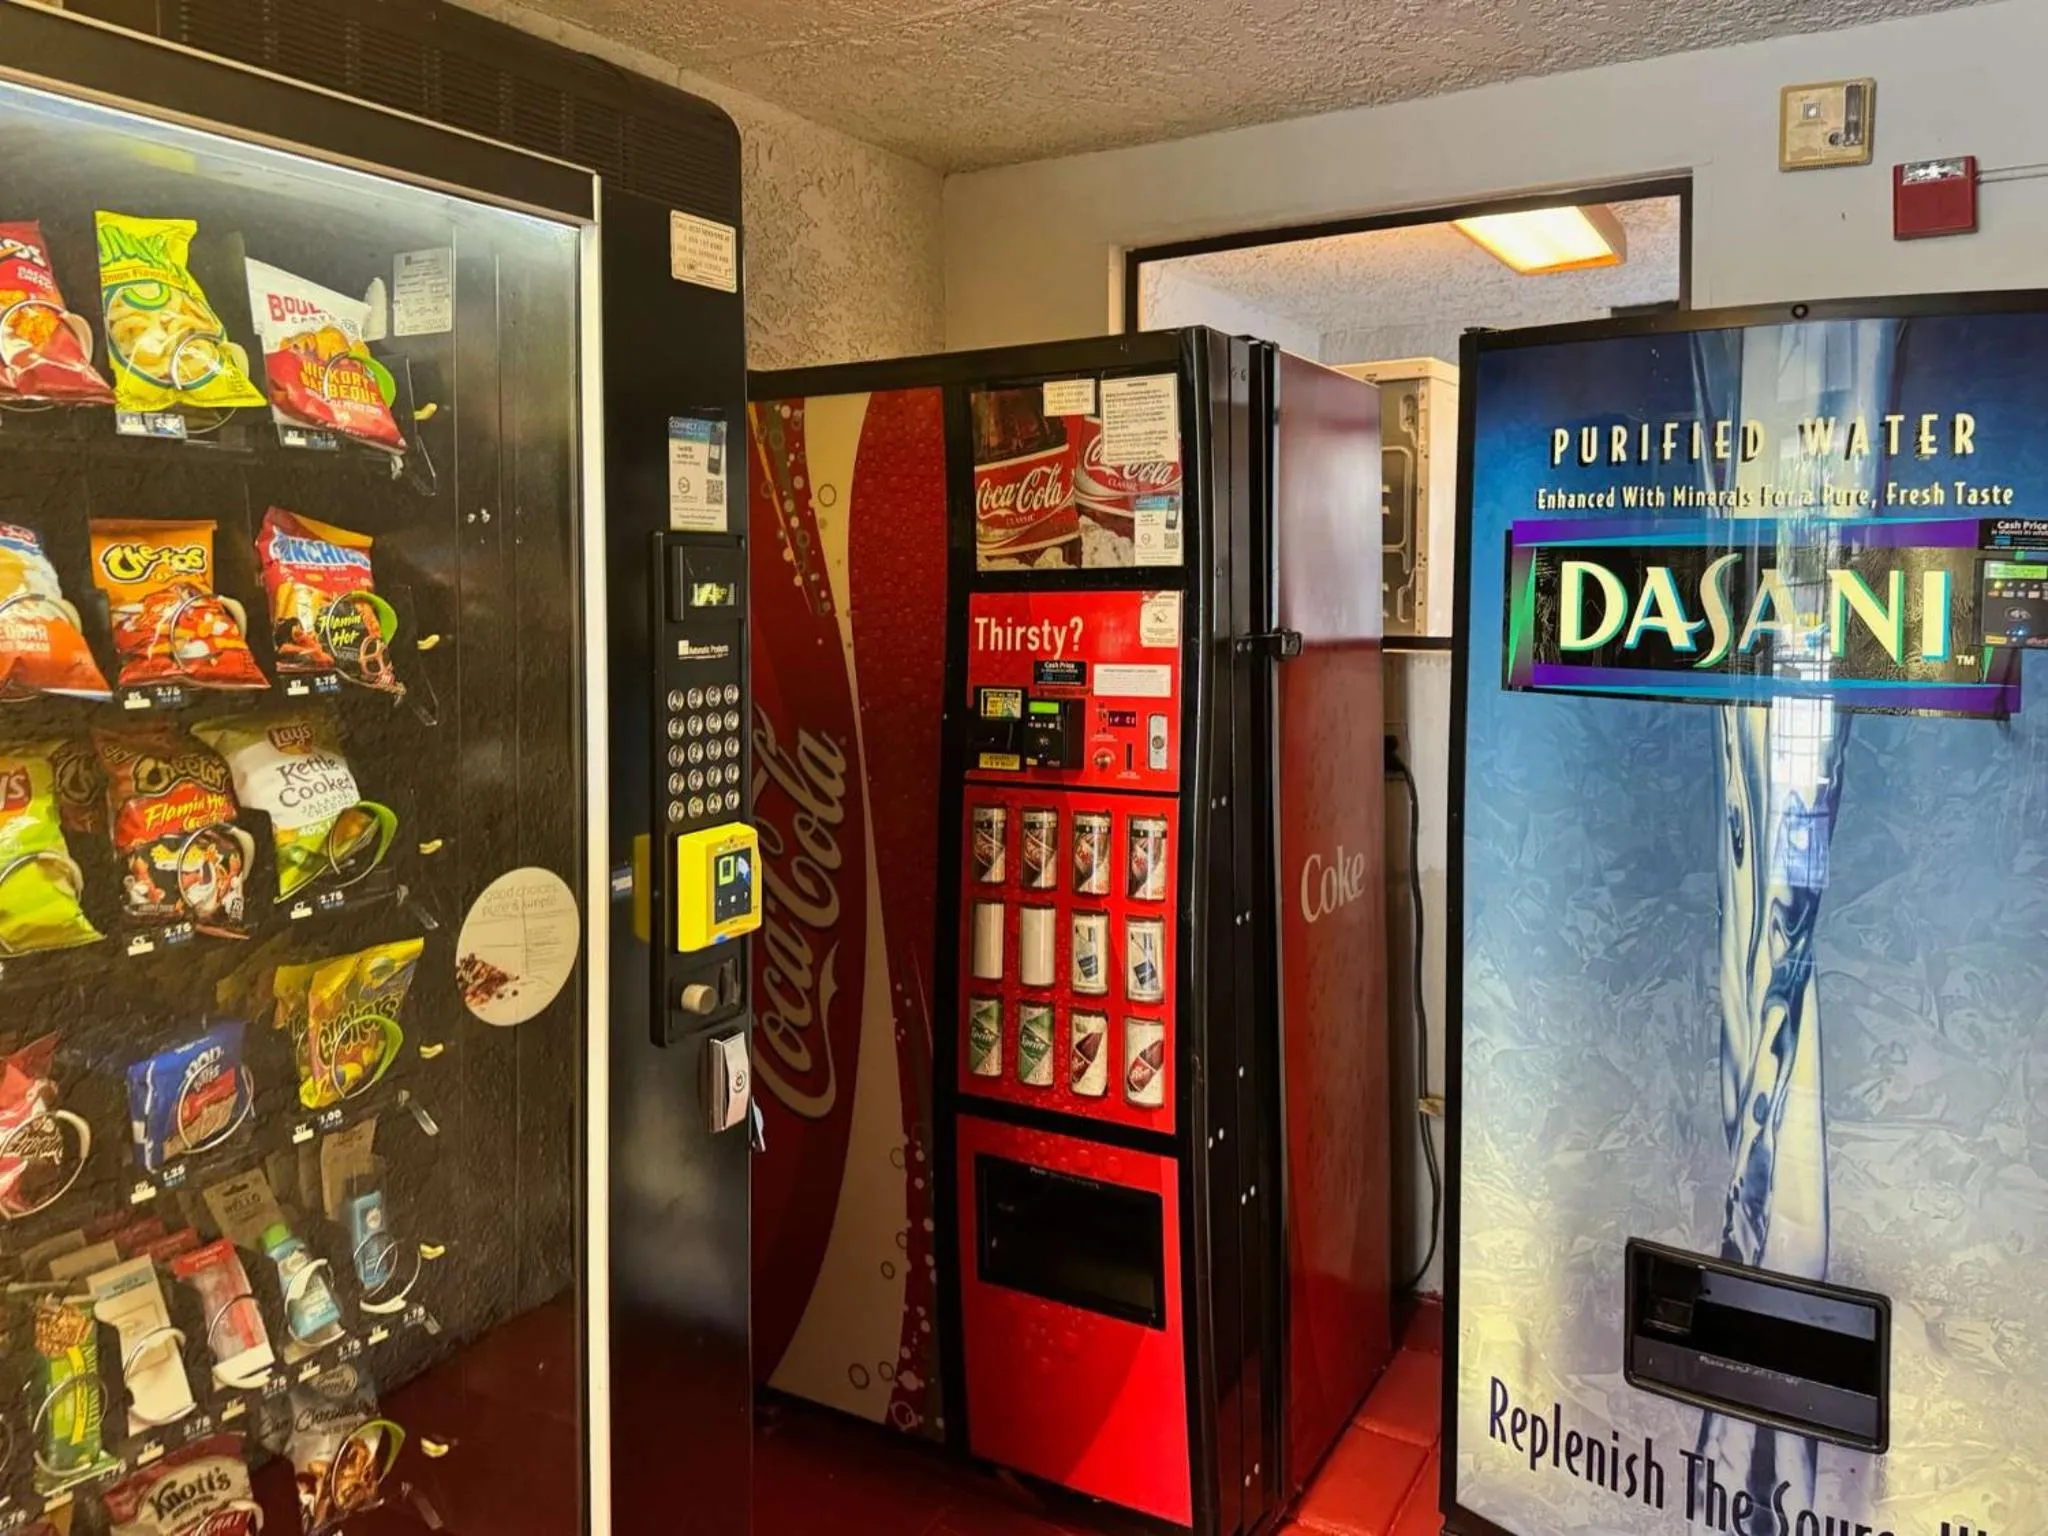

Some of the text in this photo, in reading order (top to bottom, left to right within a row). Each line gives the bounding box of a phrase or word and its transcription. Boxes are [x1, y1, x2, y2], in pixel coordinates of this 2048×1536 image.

[267, 293, 322, 323] BOUL
[300, 371, 379, 405] BABEQUE
[1552, 412, 1978, 468] PURIFIED WATER
[976, 462, 1074, 521] Coca-Cola
[1538, 487, 1615, 510] Enhanced
[1622, 485, 1665, 509] With
[1672, 484, 1753, 509] Minerals
[1761, 484, 1795, 507] For
[1823, 482, 1878, 510] Pure,
[1886, 481, 1946, 505] Fresh
[1953, 480, 2014, 506] Taste
[1996, 520, 2048, 530] Cash Price
[1559, 552, 1952, 668] DASANI
[974, 615, 1085, 661] Thirsty?
[275, 751, 340, 787] Kettle
[1300, 844, 1366, 924] Coke
[1489, 1374, 1667, 1511] Replenish
[1679, 1447, 1755, 1530] The
[150, 1466, 232, 1519] Knott's
